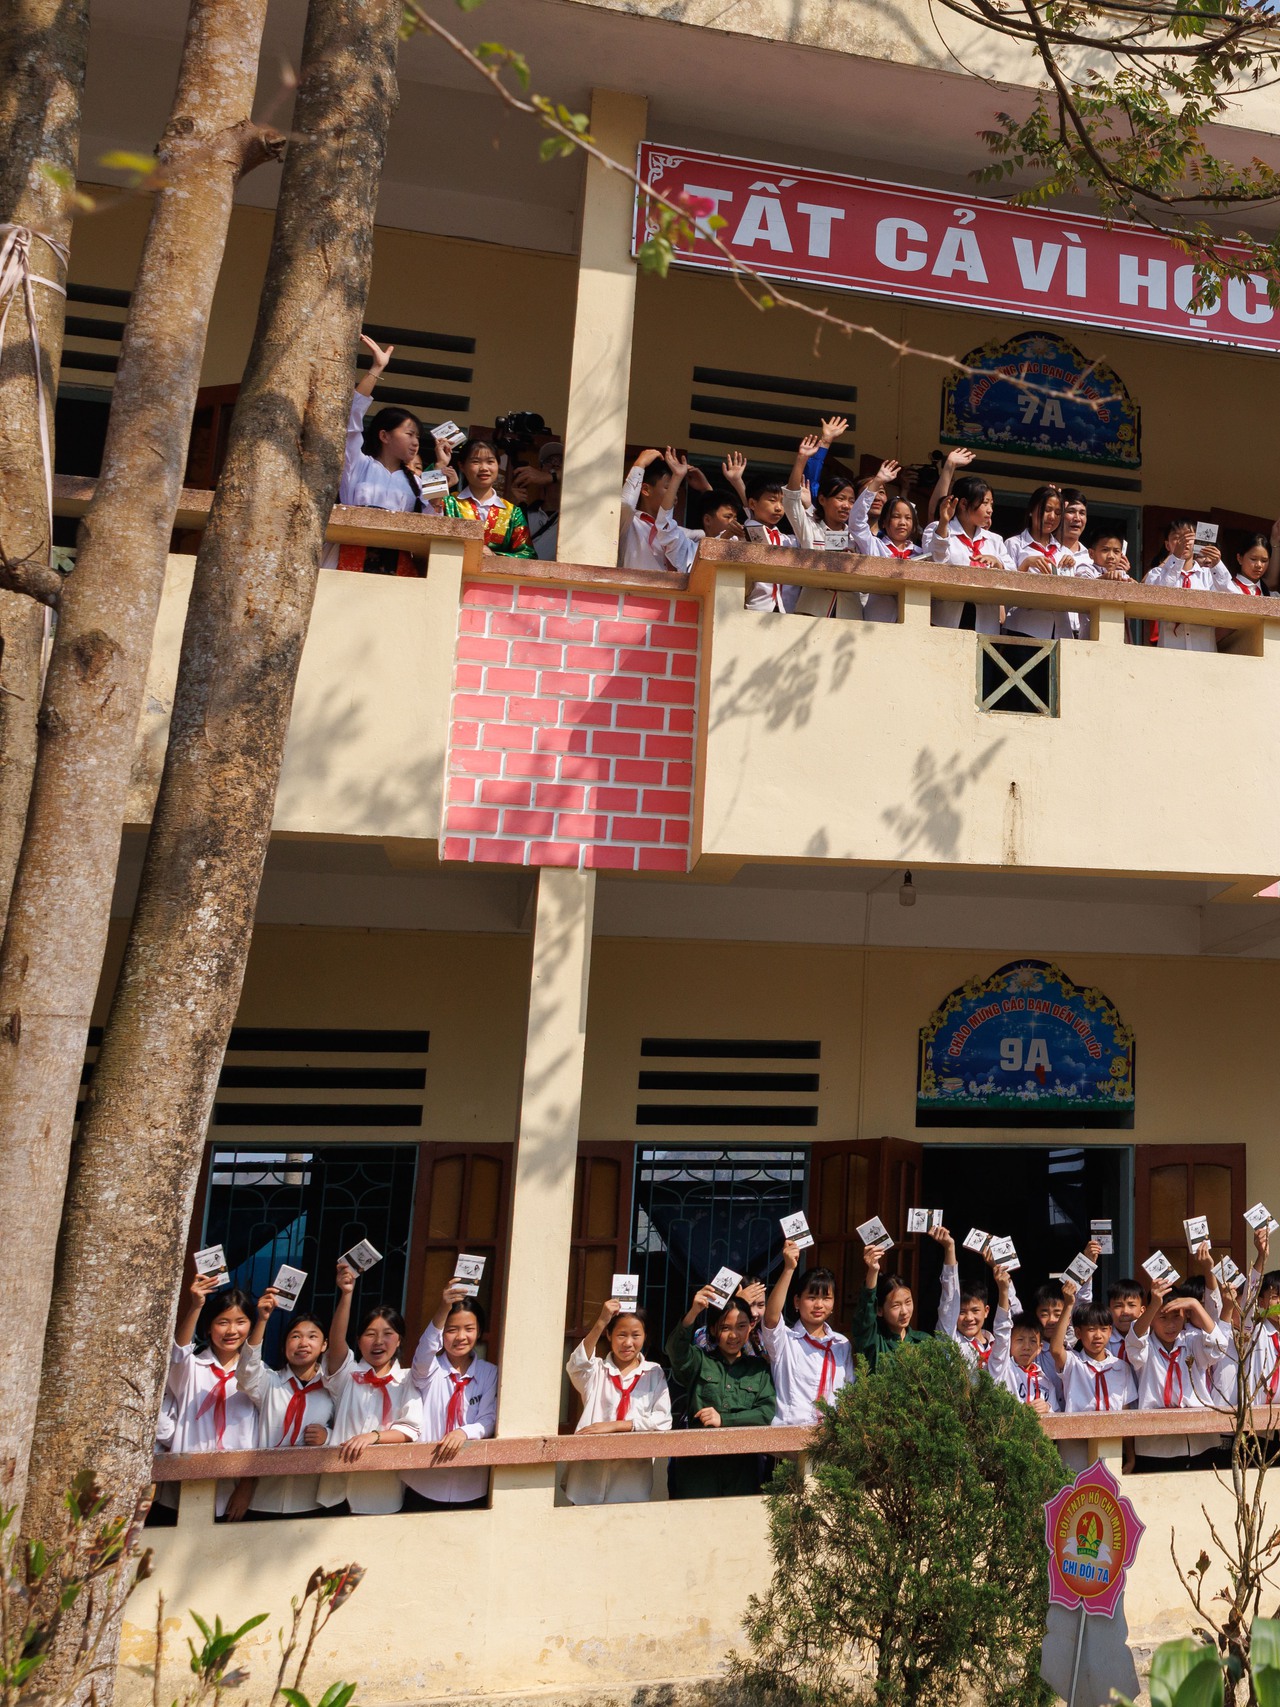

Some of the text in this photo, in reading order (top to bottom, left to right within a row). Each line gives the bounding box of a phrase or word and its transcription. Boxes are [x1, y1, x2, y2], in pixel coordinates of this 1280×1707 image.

[683, 178, 845, 259] TẤT
[875, 208, 989, 284] CẢ
[1012, 230, 1087, 298] VÌ
[1119, 253, 1275, 328] HỌC
[1018, 394, 1066, 430] 7A
[948, 997, 1102, 1058] CHÀO MỪNG CÁC BẠN ĐẾN VỚI LỚP
[1000, 1037, 1052, 1071] 9A
[1066, 1493, 1085, 1516] TNTP
[1100, 1496, 1115, 1516] CHÍ
[1110, 1515, 1121, 1550] MINH
[1062, 1558, 1109, 1583] CHI ĐỘI 7A
